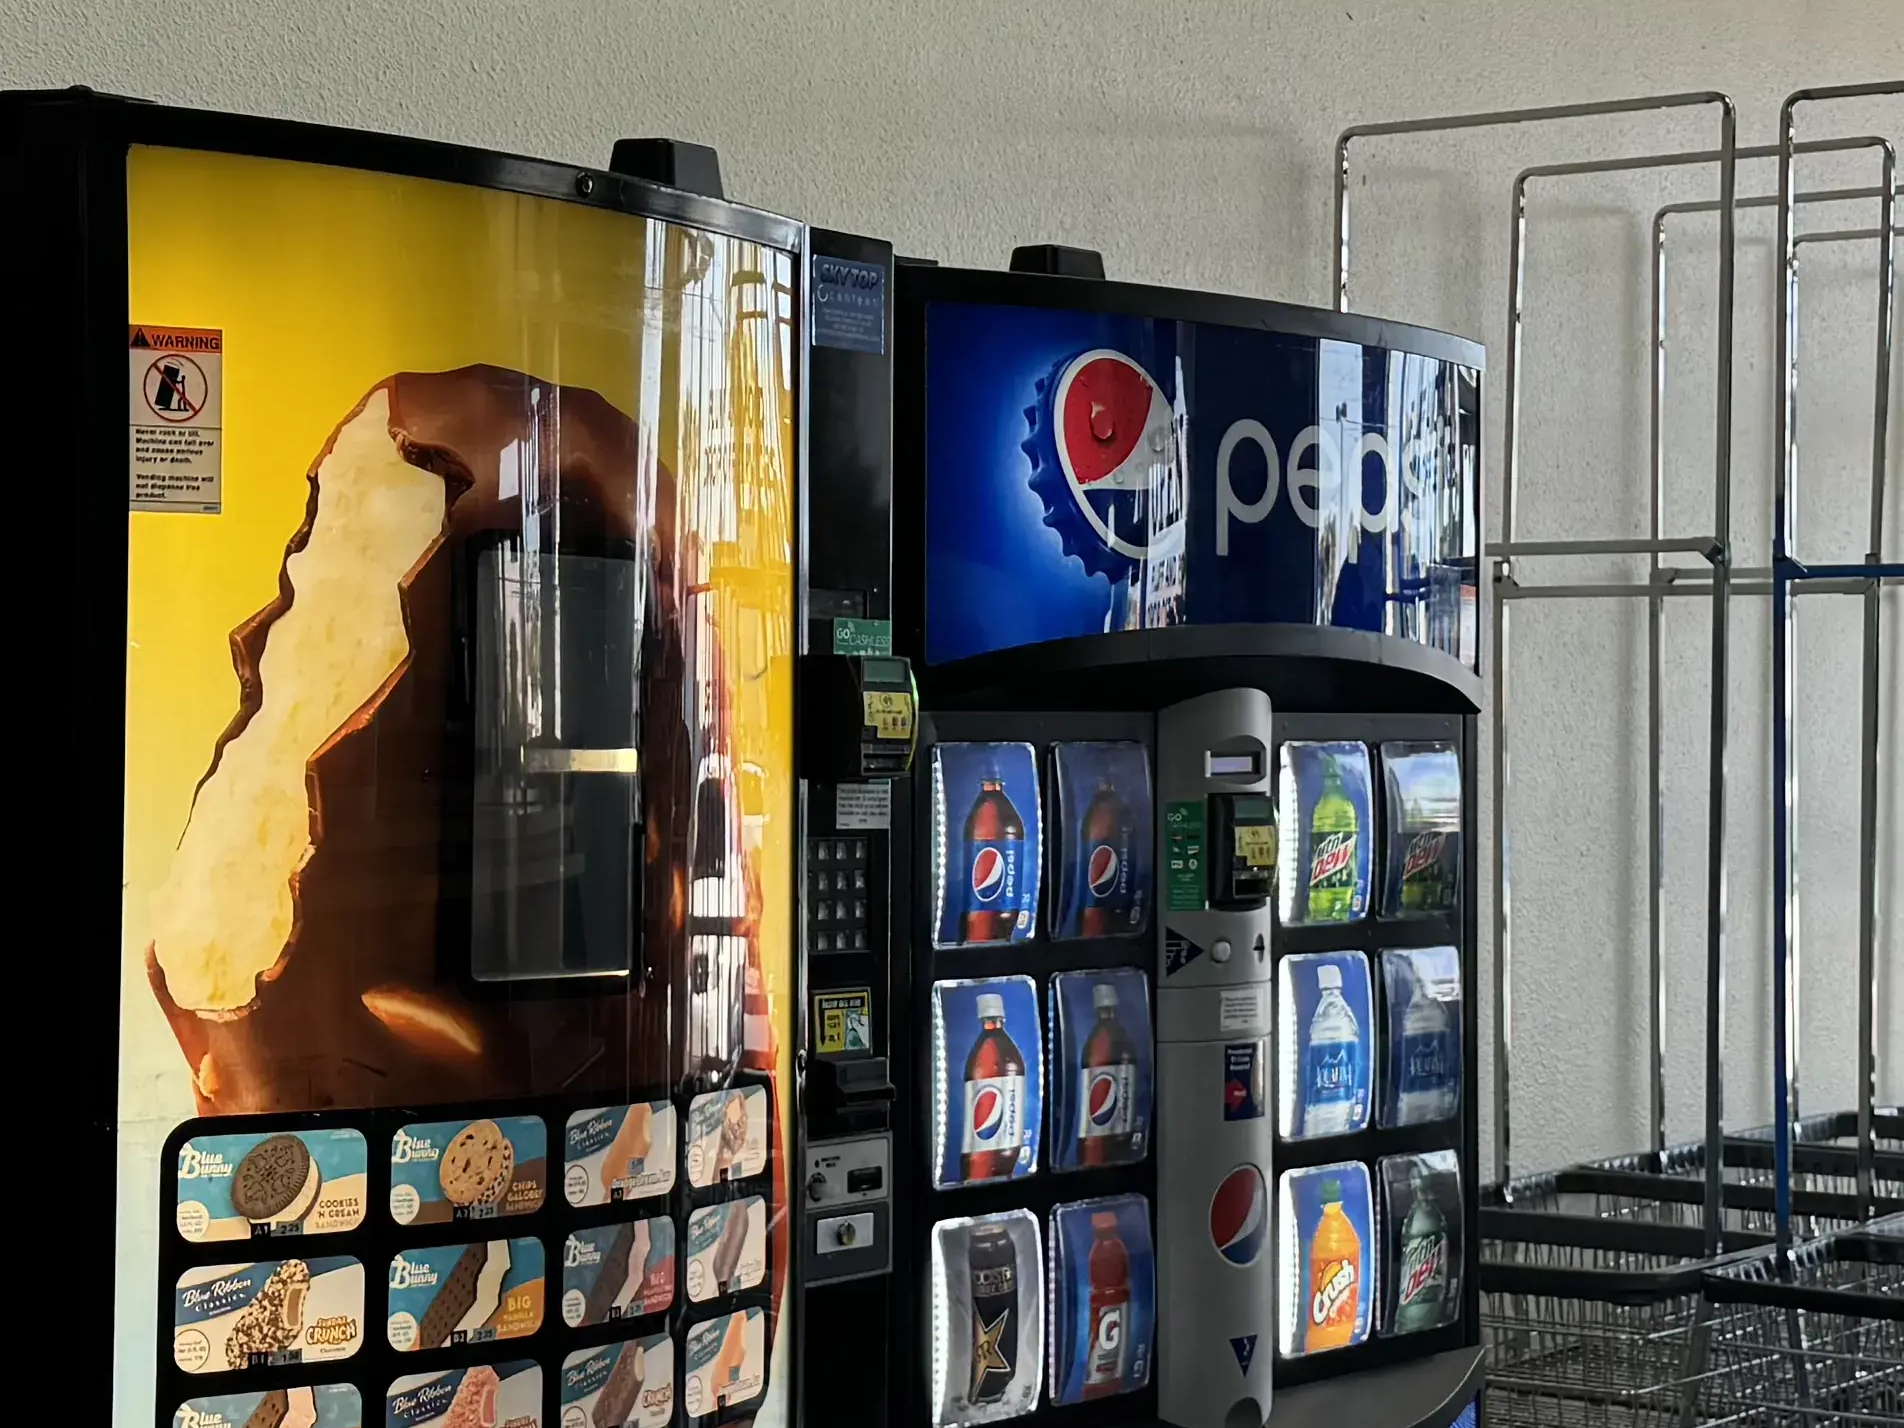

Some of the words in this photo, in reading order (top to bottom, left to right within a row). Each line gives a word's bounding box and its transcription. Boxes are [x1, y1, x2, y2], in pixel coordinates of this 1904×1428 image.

[152, 334, 219, 350] WARNING
[836, 628, 850, 639] GO
[319, 1198, 360, 1209] COOKIES
[1313, 1259, 1354, 1324] Crush
[507, 1295, 531, 1311] BIG
[305, 1319, 357, 1346] CRUNCH
[1099, 1310, 1120, 1350] G
